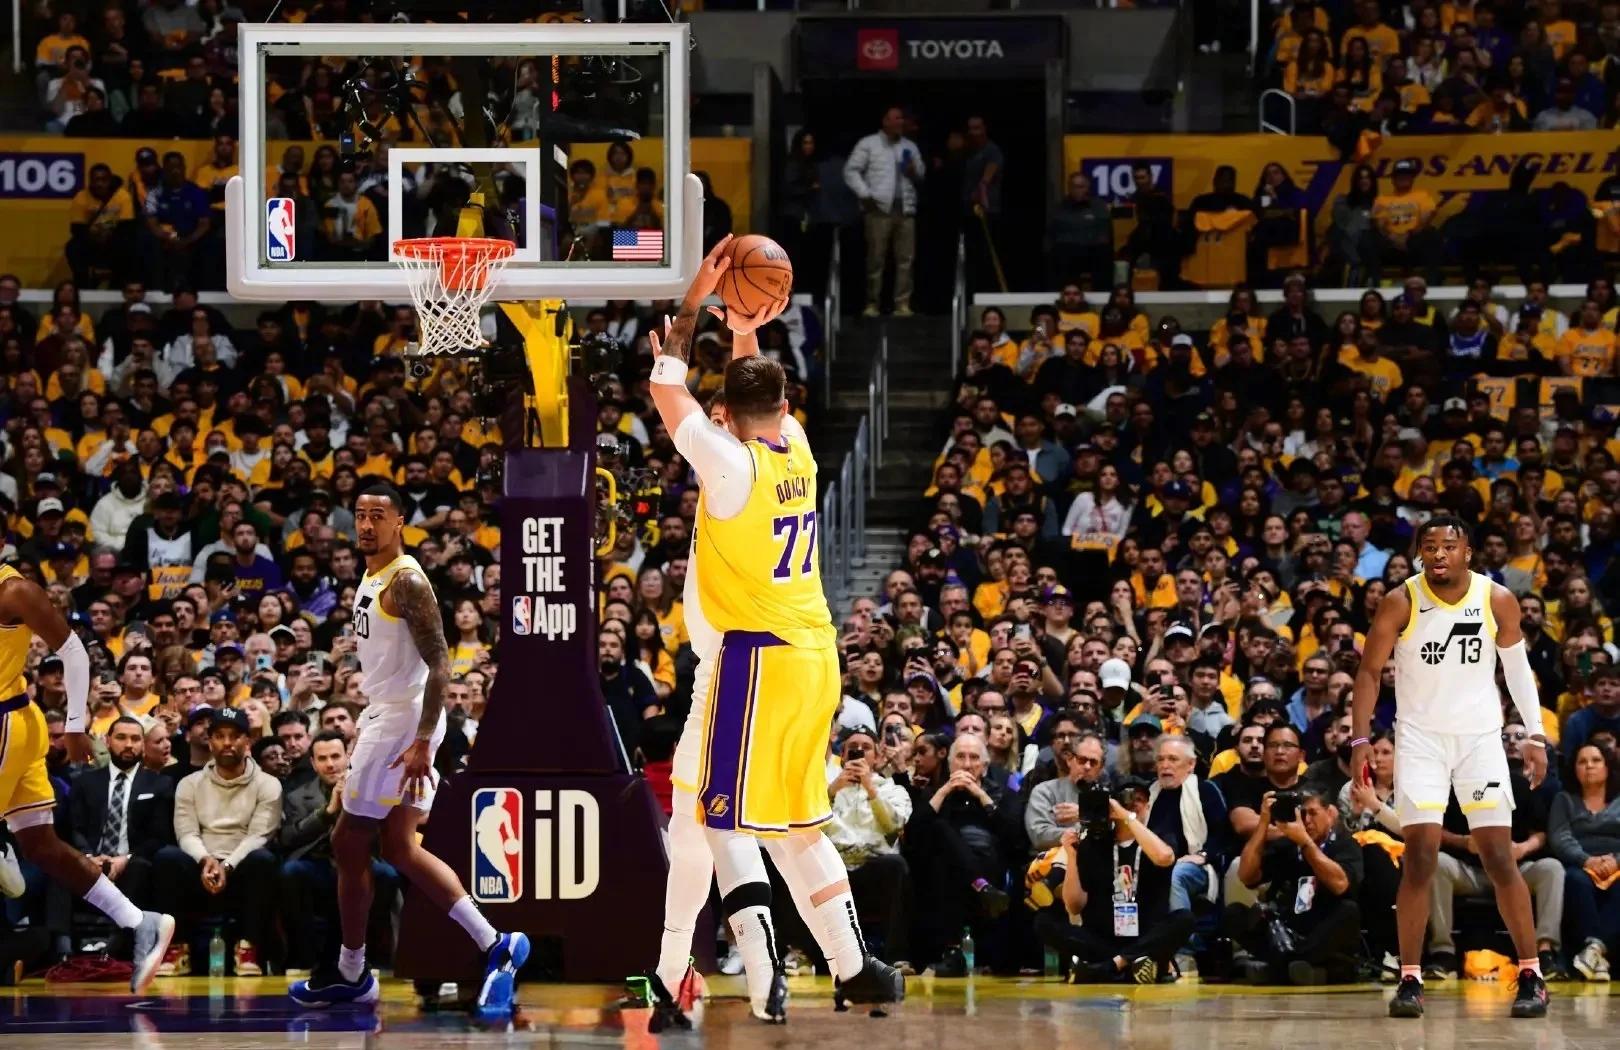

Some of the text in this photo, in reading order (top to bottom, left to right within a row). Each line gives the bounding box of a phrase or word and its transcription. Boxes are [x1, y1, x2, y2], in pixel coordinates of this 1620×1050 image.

[908, 39, 1004, 59] TOYOTA
[0, 160, 76, 192] 106
[522, 517, 565, 554] GET
[773, 510, 816, 580] 77
[522, 556, 566, 592] THE
[356, 609, 369, 639] 20
[532, 595, 577, 641] App
[1464, 608, 1481, 617] LVT
[1457, 637, 1483, 664] 13
[535, 789, 600, 900] iD
[479, 876, 504, 896] NBA
